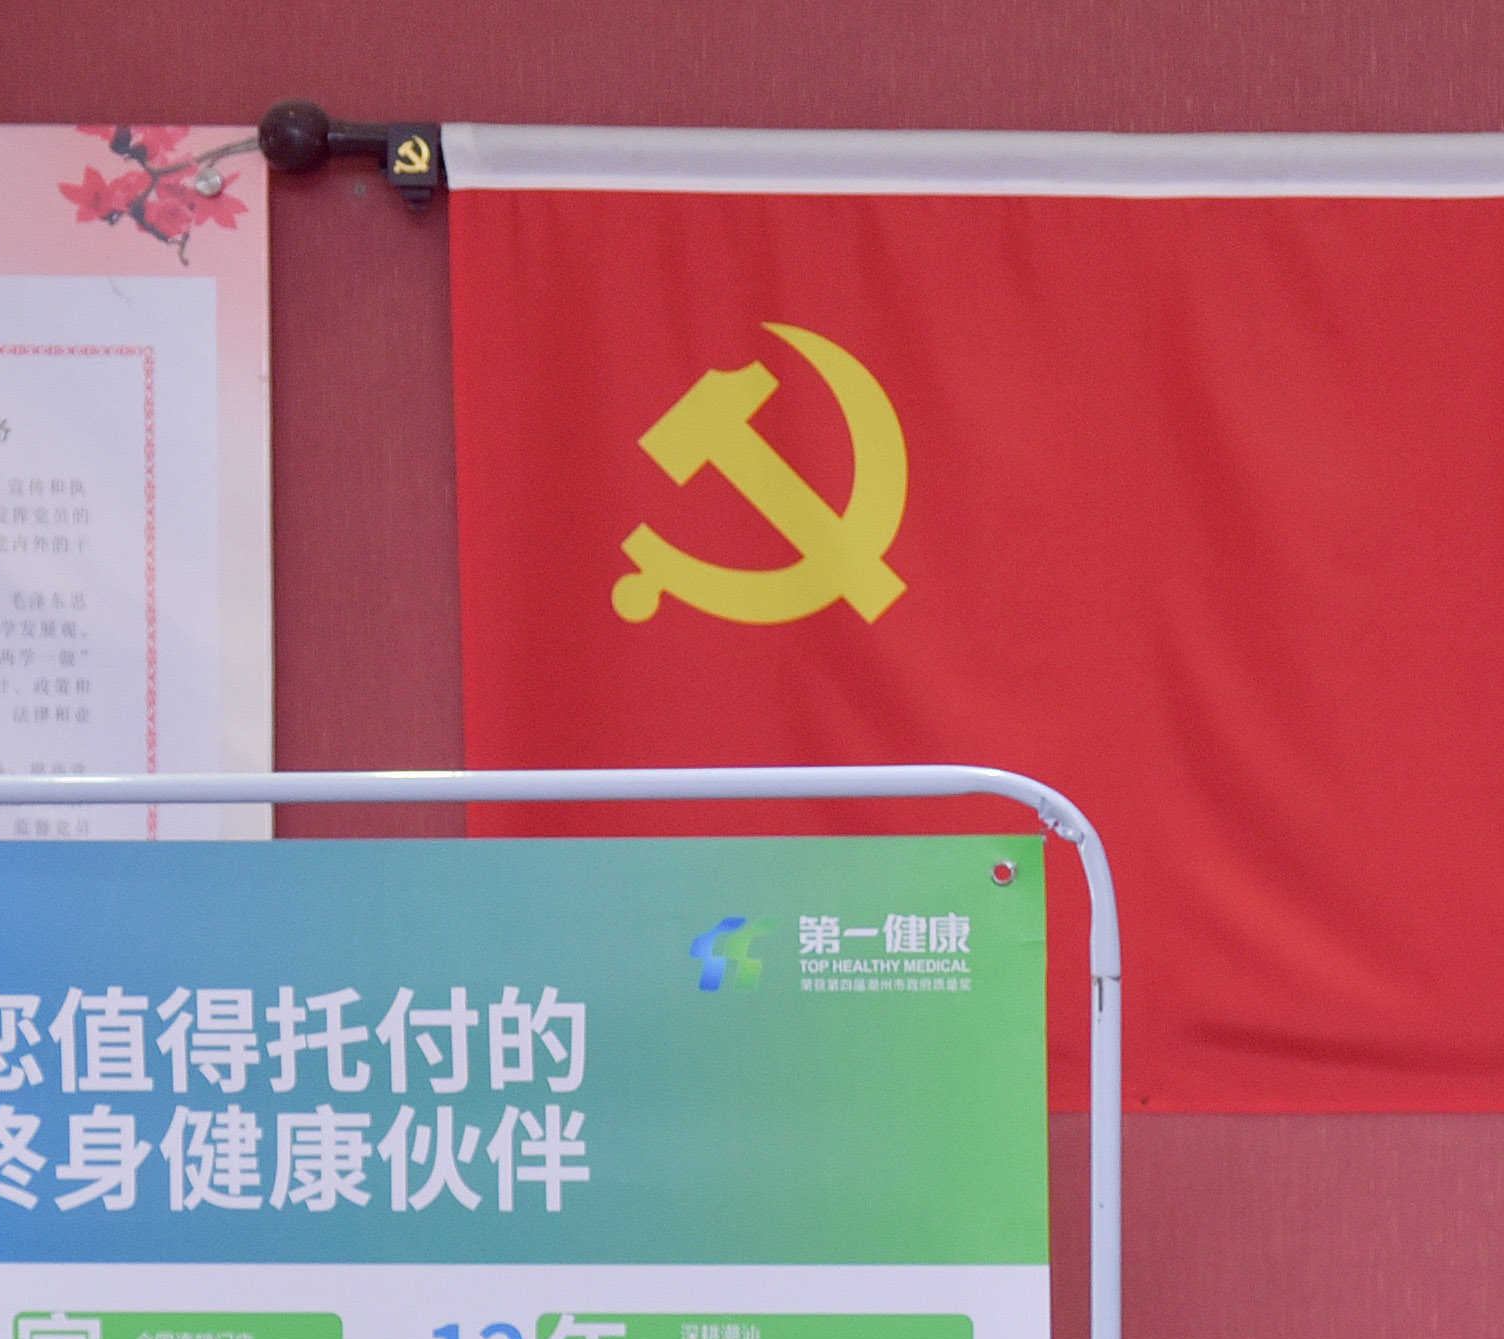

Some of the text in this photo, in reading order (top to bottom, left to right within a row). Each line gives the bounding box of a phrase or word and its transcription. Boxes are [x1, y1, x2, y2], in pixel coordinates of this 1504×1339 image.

[799, 911, 971, 955] 第一健康
[800, 959, 971, 974] TOP HEALTHY MEDICAL
